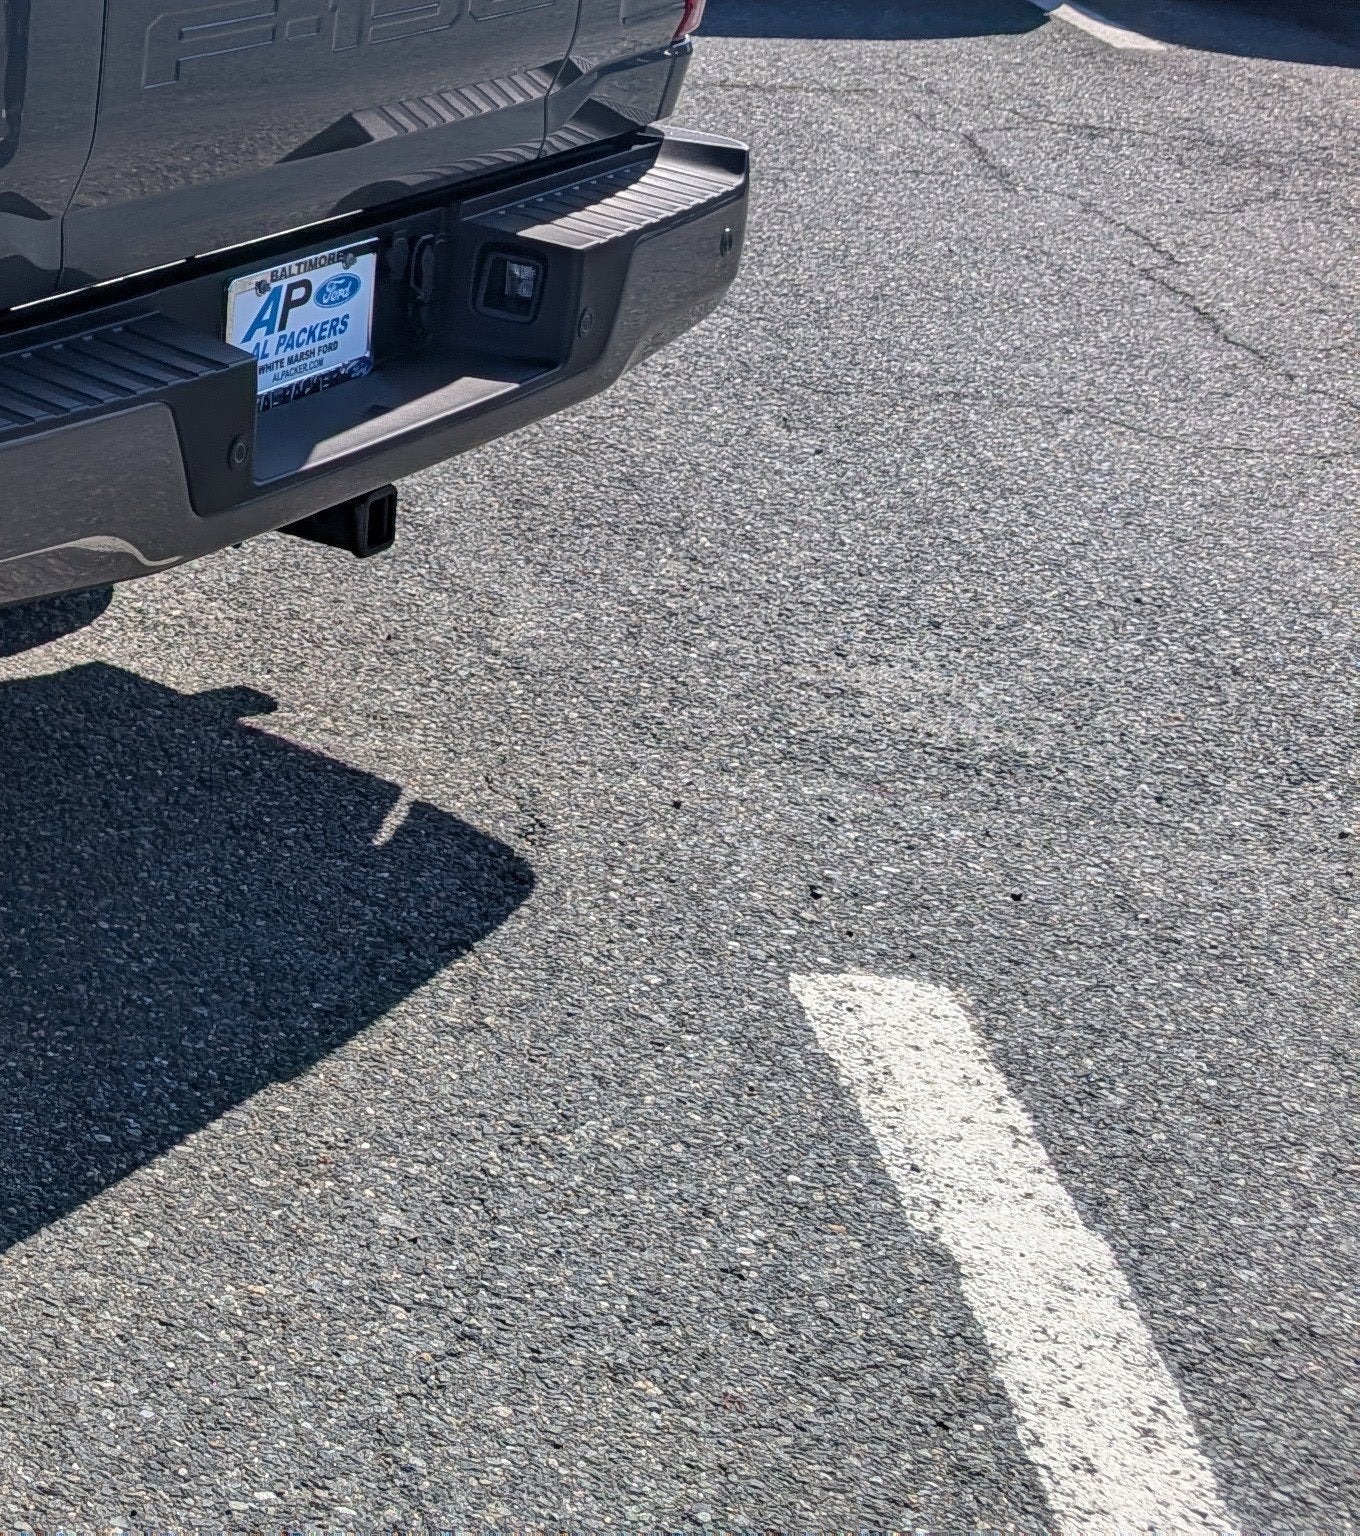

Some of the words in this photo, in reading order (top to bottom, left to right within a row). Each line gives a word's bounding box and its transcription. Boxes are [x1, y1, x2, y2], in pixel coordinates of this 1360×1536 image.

[270, 252, 345, 282] BALTIMORE
[322, 277, 353, 305] Ford
[240, 278, 313, 344] AP
[252, 340, 270, 362] AL
[275, 314, 350, 355] PACKERS
[258, 359, 285, 376] WHITE
[287, 348, 316, 365] MARSH
[317, 340, 339, 356] FORD
